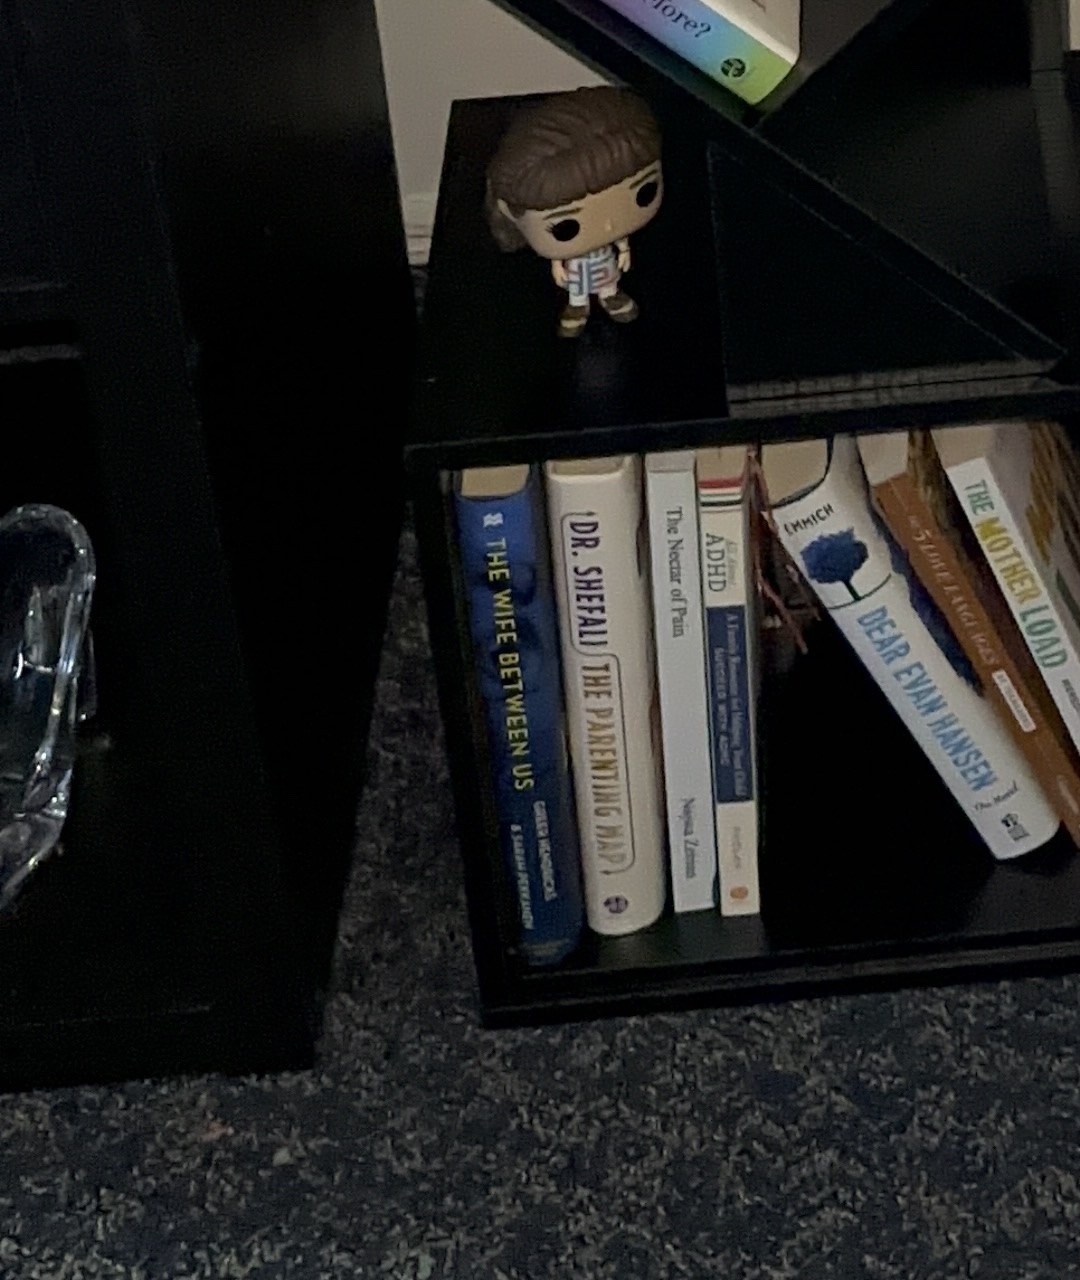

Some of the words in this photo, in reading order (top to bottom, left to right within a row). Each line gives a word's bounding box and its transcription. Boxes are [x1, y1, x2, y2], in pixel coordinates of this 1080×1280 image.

[964, 478, 995, 516] THE
[569, 520, 600, 558] DR.
[666, 506, 683, 535] The
[486, 537, 512, 582] THE
[667, 538, 685, 585] Nectar
[705, 532, 727, 593] ADHD
[975, 515, 1042, 606] MOTHER
[492, 588, 517, 645] WIFE
[573, 565, 609, 646] SHEFALI
[670, 587, 688, 605] of
[671, 608, 688, 639] Pain
[1018, 604, 1069, 669] LOAD
[581, 662, 612, 700] THE
[857, 606, 911, 666] DEAR
[893, 660, 948, 717] EVAN
[927, 712, 998, 792] HANSEN
[498, 652, 530, 757] BETWEEN
[511, 763, 534, 791] US
[586, 707, 625, 818] PARENTING
[596, 824, 626, 864] MAP
